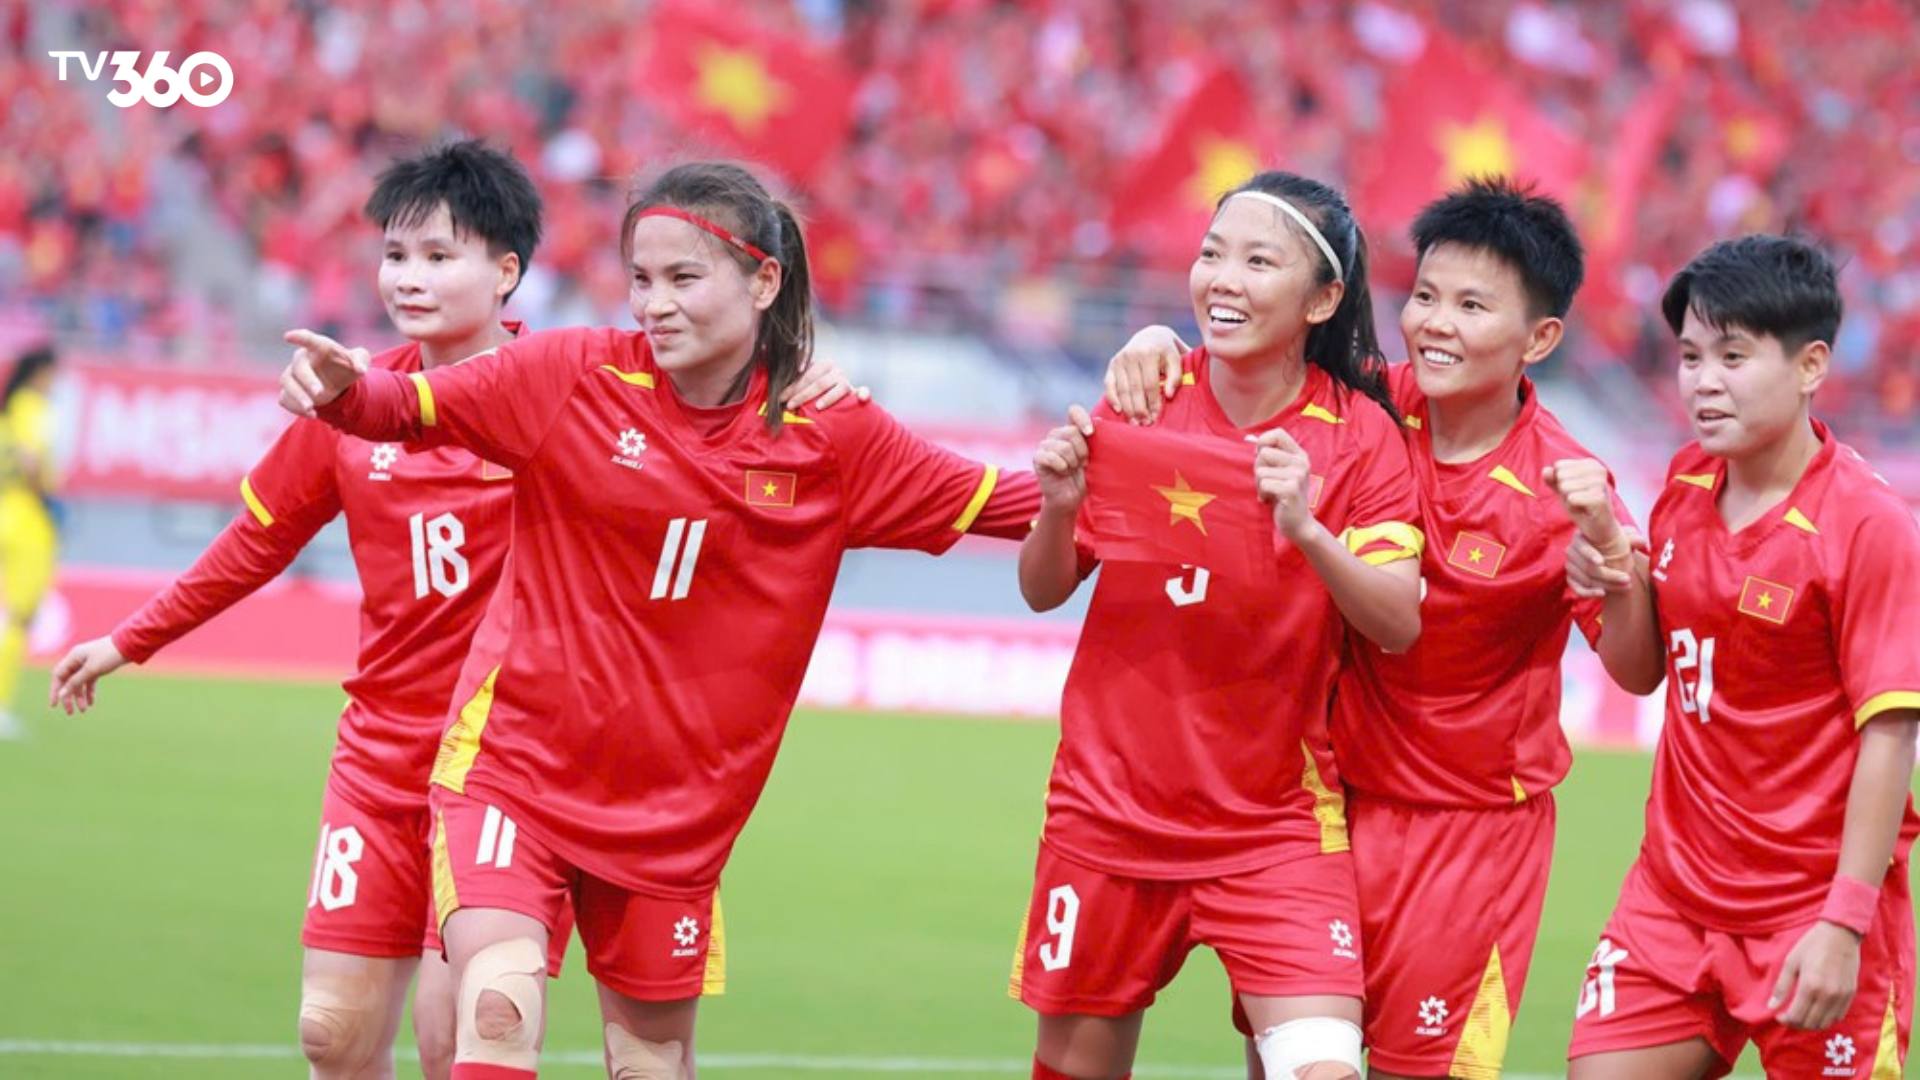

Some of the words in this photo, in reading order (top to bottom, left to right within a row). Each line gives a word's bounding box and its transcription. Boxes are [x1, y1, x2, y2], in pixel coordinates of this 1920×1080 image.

[409, 512, 469, 599] 18
[650, 518, 707, 600] 11
[1670, 628, 1715, 723] 21
[307, 822, 365, 911] 18
[475, 804, 517, 868] 11
[1039, 884, 1080, 971] 9
